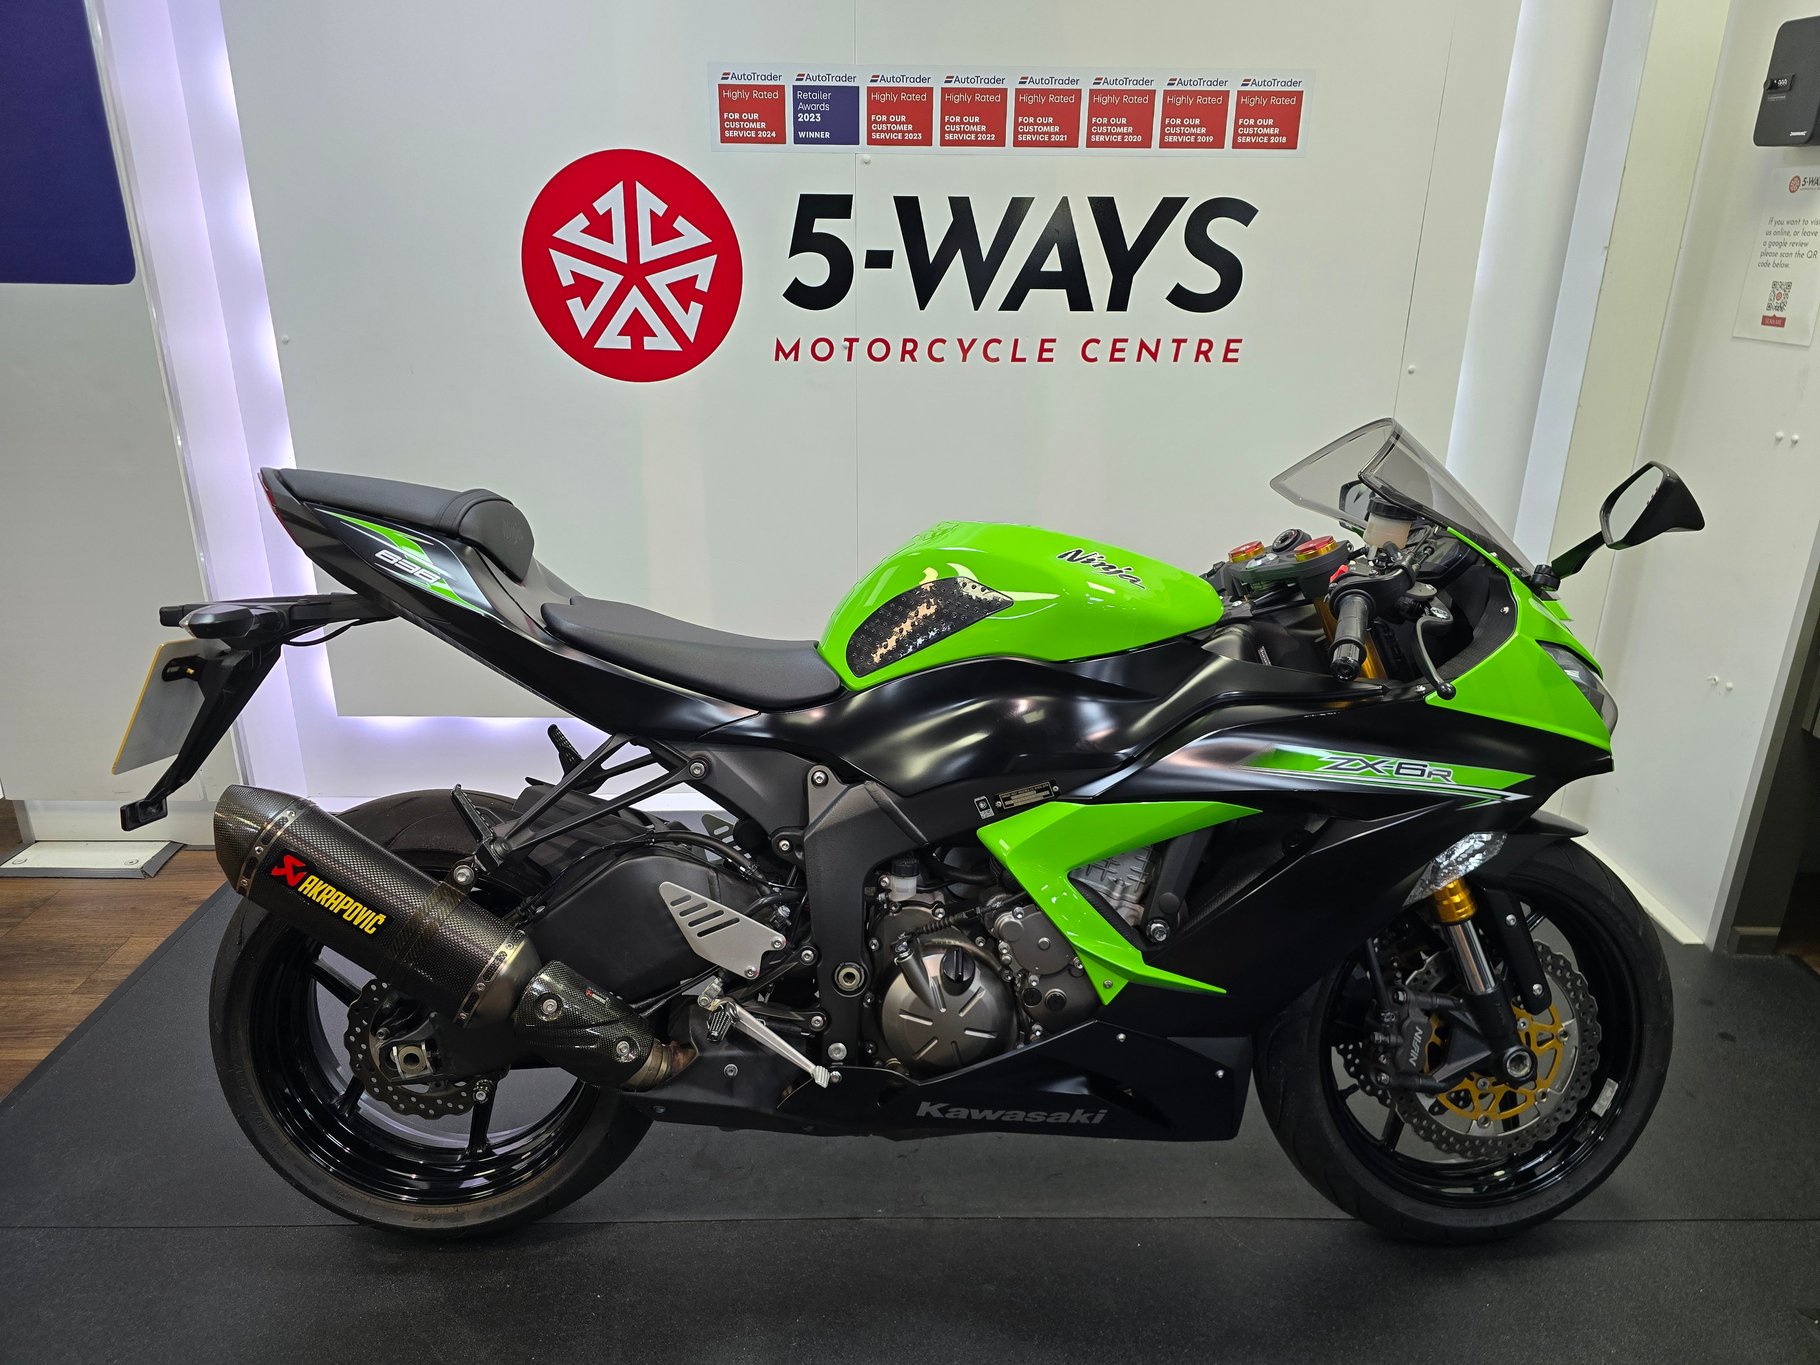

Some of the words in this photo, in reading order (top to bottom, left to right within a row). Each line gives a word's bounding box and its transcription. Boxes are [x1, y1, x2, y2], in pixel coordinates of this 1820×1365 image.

[730, 72, 782, 82] AutoTrader
[805, 74, 856, 83] AutoTrader
[880, 74, 930, 84] AutoTrader
[954, 76, 1006, 85] AutoTrader
[1028, 76, 1080, 86] AutoTrader
[1102, 77, 1154, 86] AutoTrader
[1176, 77, 1228, 87] AutoTrader
[1250, 78, 1302, 88] AutoTrader
[723, 90, 750, 100] Highly
[752, 90, 778, 99] Rated
[797, 90, 832, 100] Retailer
[872, 92, 898, 102] Highly
[900, 92, 926, 102] Rated
[945, 94, 972, 103] Highly
[974, 94, 1000, 102] Rated
[1019, 94, 1046, 104] Highly
[1049, 94, 1074, 103] Rated
[1093, 94, 1120, 104] Highly
[1123, 94, 1148, 104] Rated
[1167, 95, 1194, 105] Highly
[1196, 95, 1222, 104] Rated
[1241, 96, 1268, 106] Highly
[1270, 96, 1296, 105] Rated
[798, 102, 830, 111] Awards
[798, 113, 821, 122] 2023
[944, 124, 986, 132] CUSTOMER
[724, 130, 756, 138] SERVICE
[758, 130, 776, 138] 2024
[798, 131, 830, 139] WINNER
[872, 132, 902, 140] SERVICE
[904, 132, 922, 140] 2023
[1018, 134, 1048, 142] SERVICE
[1050, 134, 1067, 142] 2021
[1802, 176, 1820, 187] 5-WA
[1801, 227, 1818, 236] leave
[1768, 238, 1788, 248] google
[782, 194, 1260, 314] 5-WAYS
[1760, 249, 1778, 258] please
[1795, 250, 1804, 258] the
[1807, 250, 1818, 258] QR
[774, 337, 1057, 363] MOTORCYCLE
[1081, 338, 1244, 364] CENTRE
[1056, 548, 1146, 590] Ninja
[916, 1101, 1108, 1124] Kawasaki
